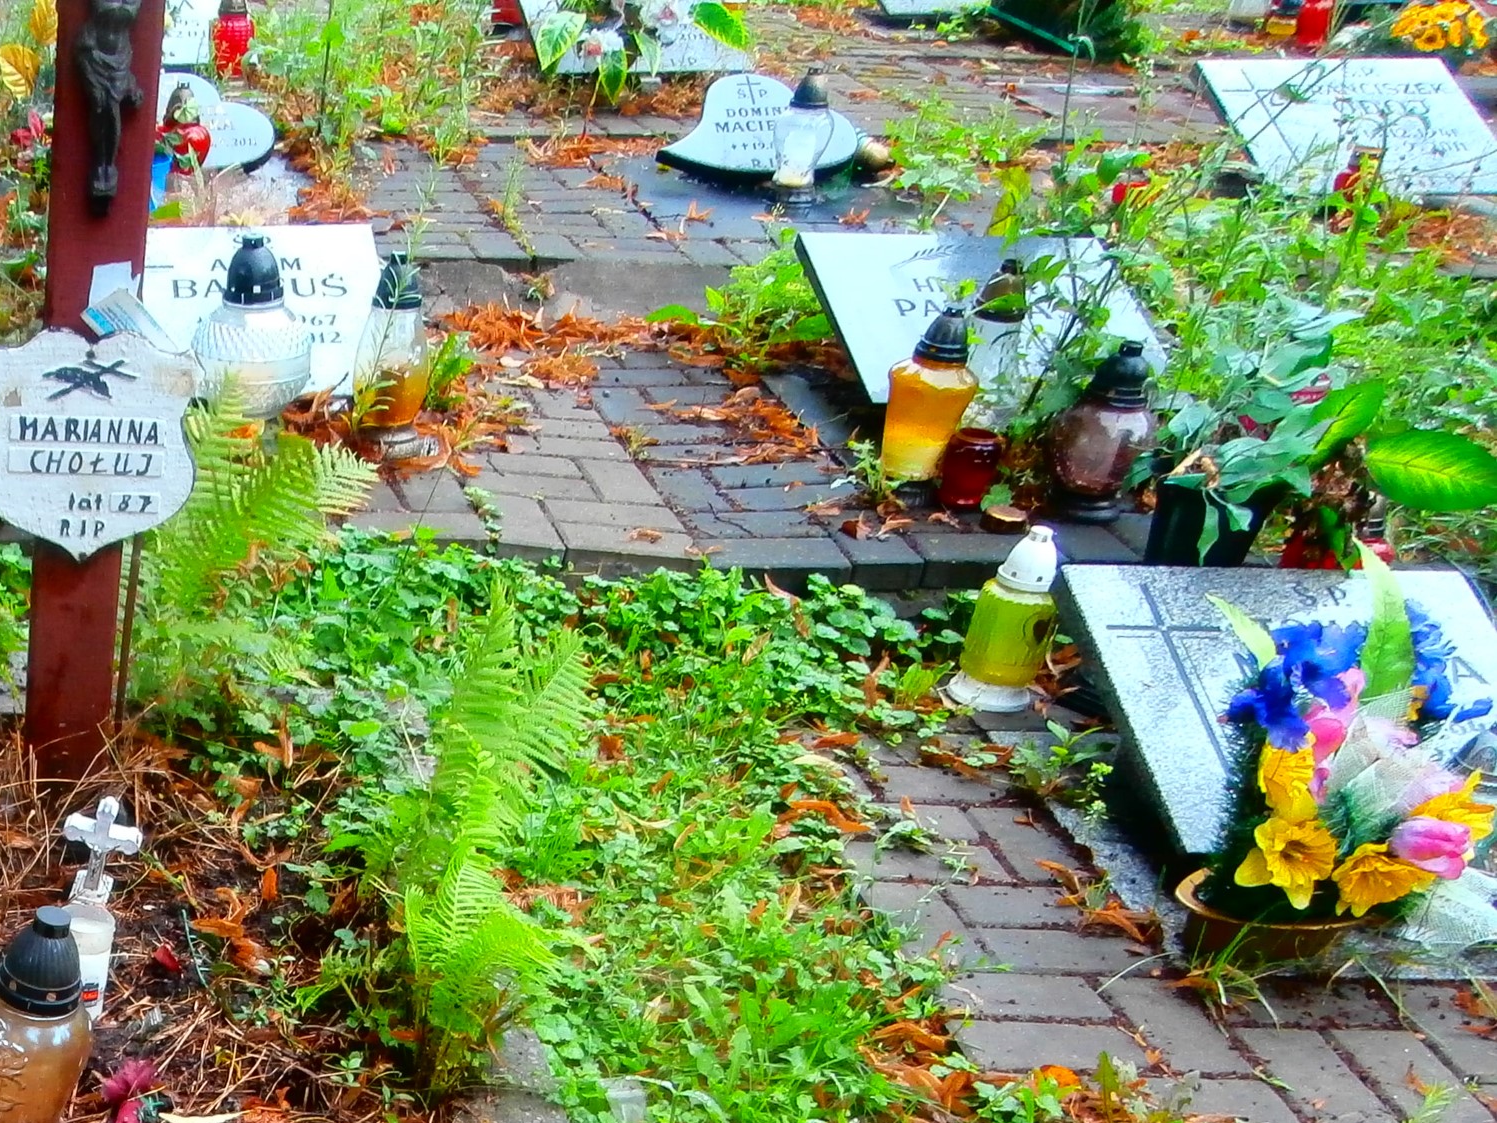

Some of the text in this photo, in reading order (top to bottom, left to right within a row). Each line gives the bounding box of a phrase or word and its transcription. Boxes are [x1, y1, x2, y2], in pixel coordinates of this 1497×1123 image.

[725, 106, 788, 118] DOMIN
[18, 415, 159, 445] MARIANNA
[29, 449, 153, 478] CHOŁUJ
[117, 494, 153, 513] 87
